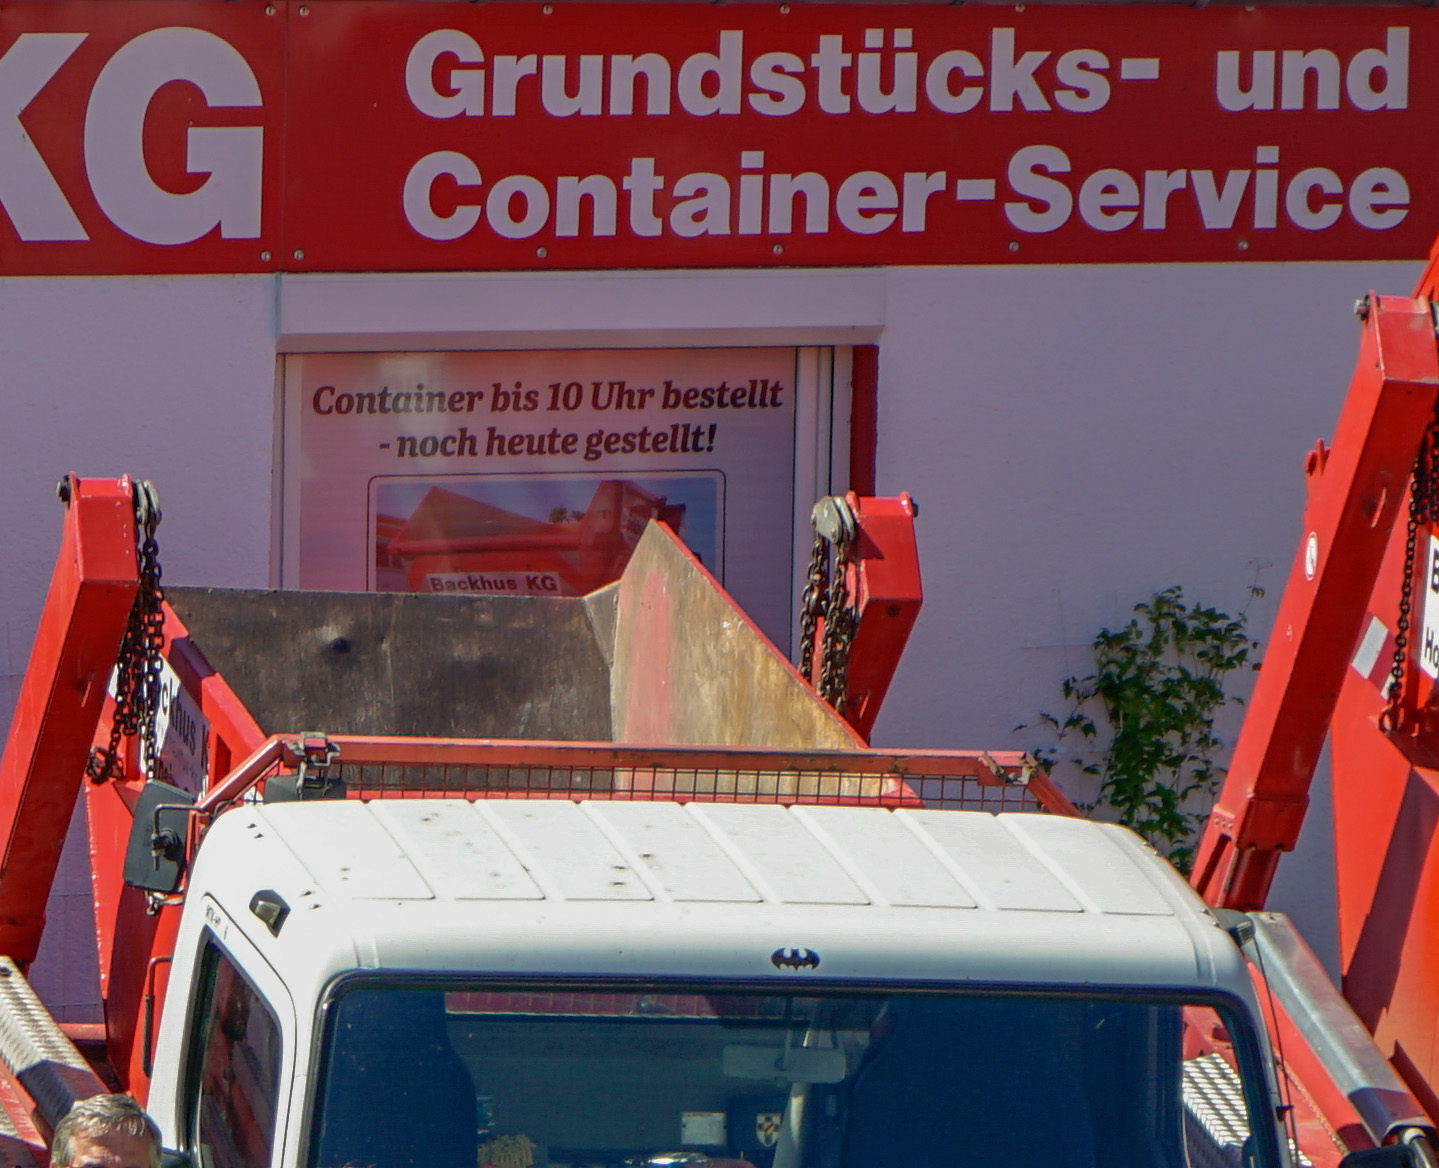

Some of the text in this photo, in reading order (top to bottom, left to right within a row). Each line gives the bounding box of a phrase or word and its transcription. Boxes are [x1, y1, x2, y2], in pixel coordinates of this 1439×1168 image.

[406, 27, 1409, 118] Grundstücks- und
[403, 145, 1410, 240] Container-Service
[312, 378, 784, 416] Container bis 10 Uhr bestellt
[397, 429, 478, 458] noch
[486, 426, 579, 456] heute
[584, 422, 717, 461] gestellt!
[429, 574, 558, 593] Backhus KG
